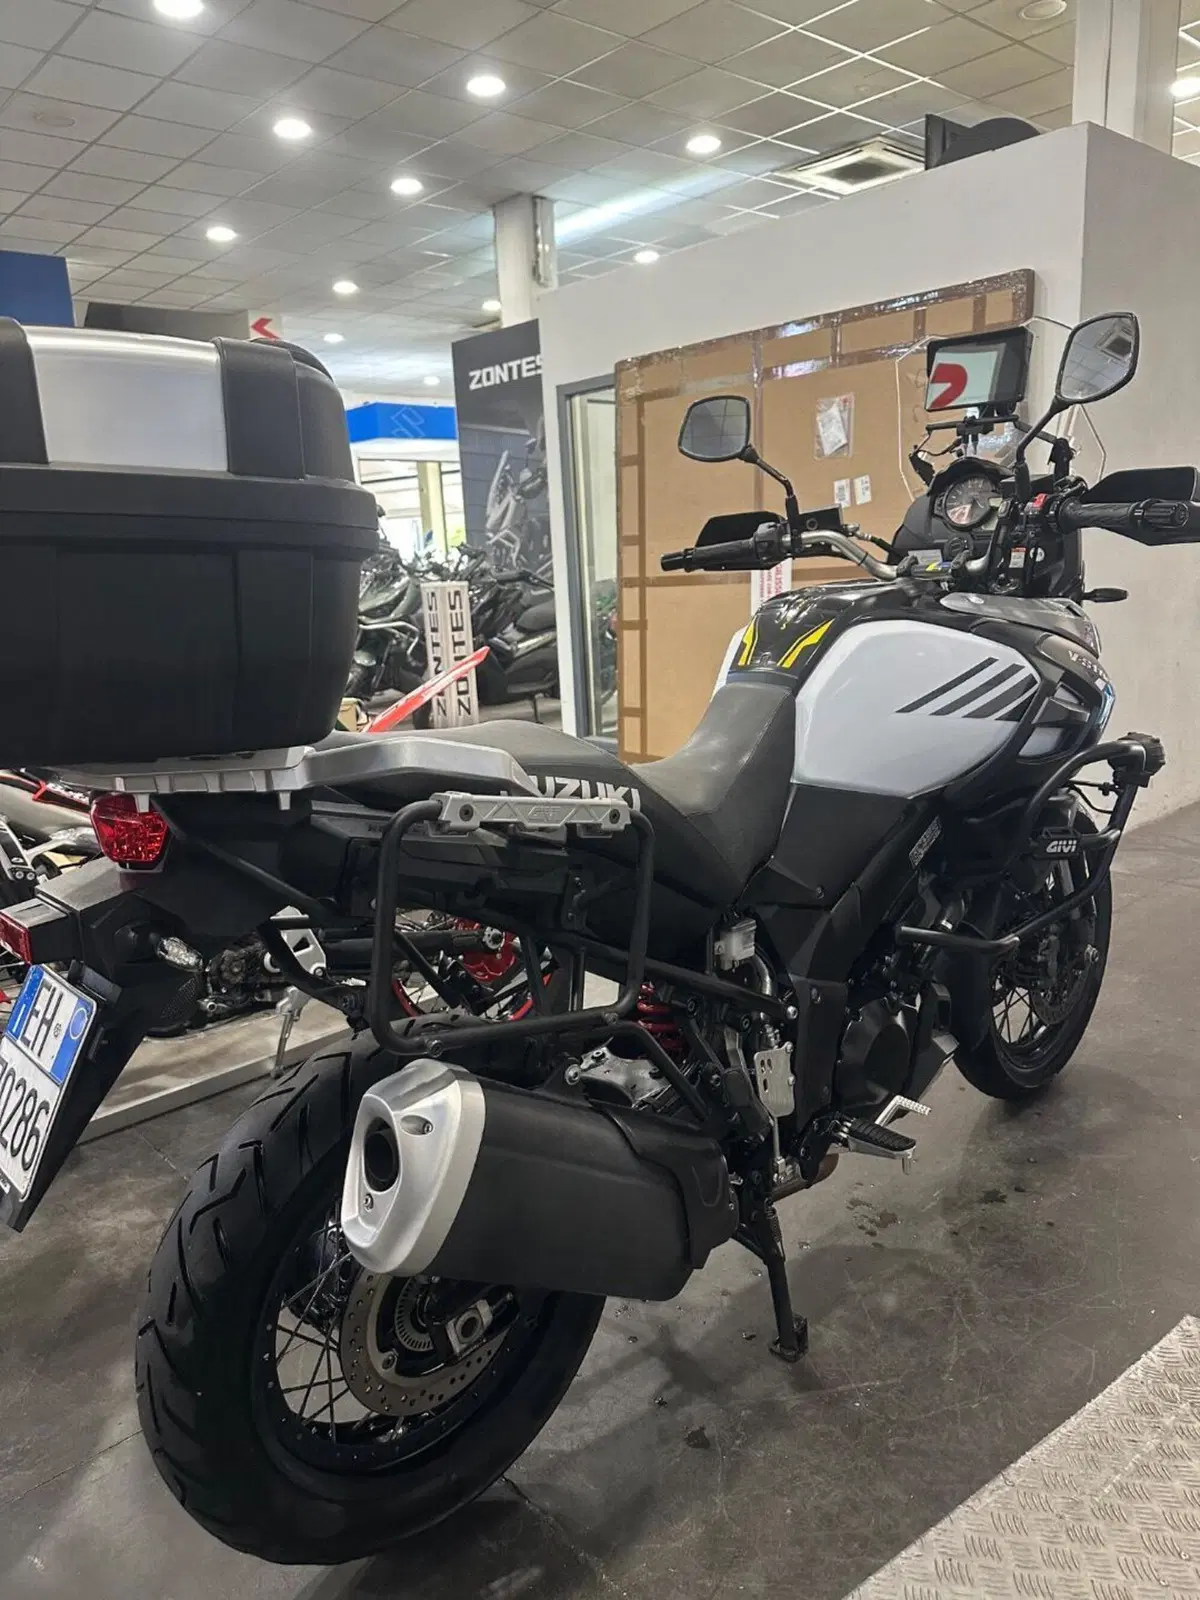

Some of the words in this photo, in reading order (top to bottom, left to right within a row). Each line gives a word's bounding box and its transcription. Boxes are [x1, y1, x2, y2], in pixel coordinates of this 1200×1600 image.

[468, 355, 543, 391] ZONTES
[426, 591, 448, 717] ZNTES
[448, 589, 473, 717] ZOTES
[500, 774, 641, 812] UZUKI
[1045, 840, 1077, 854] GIVI
